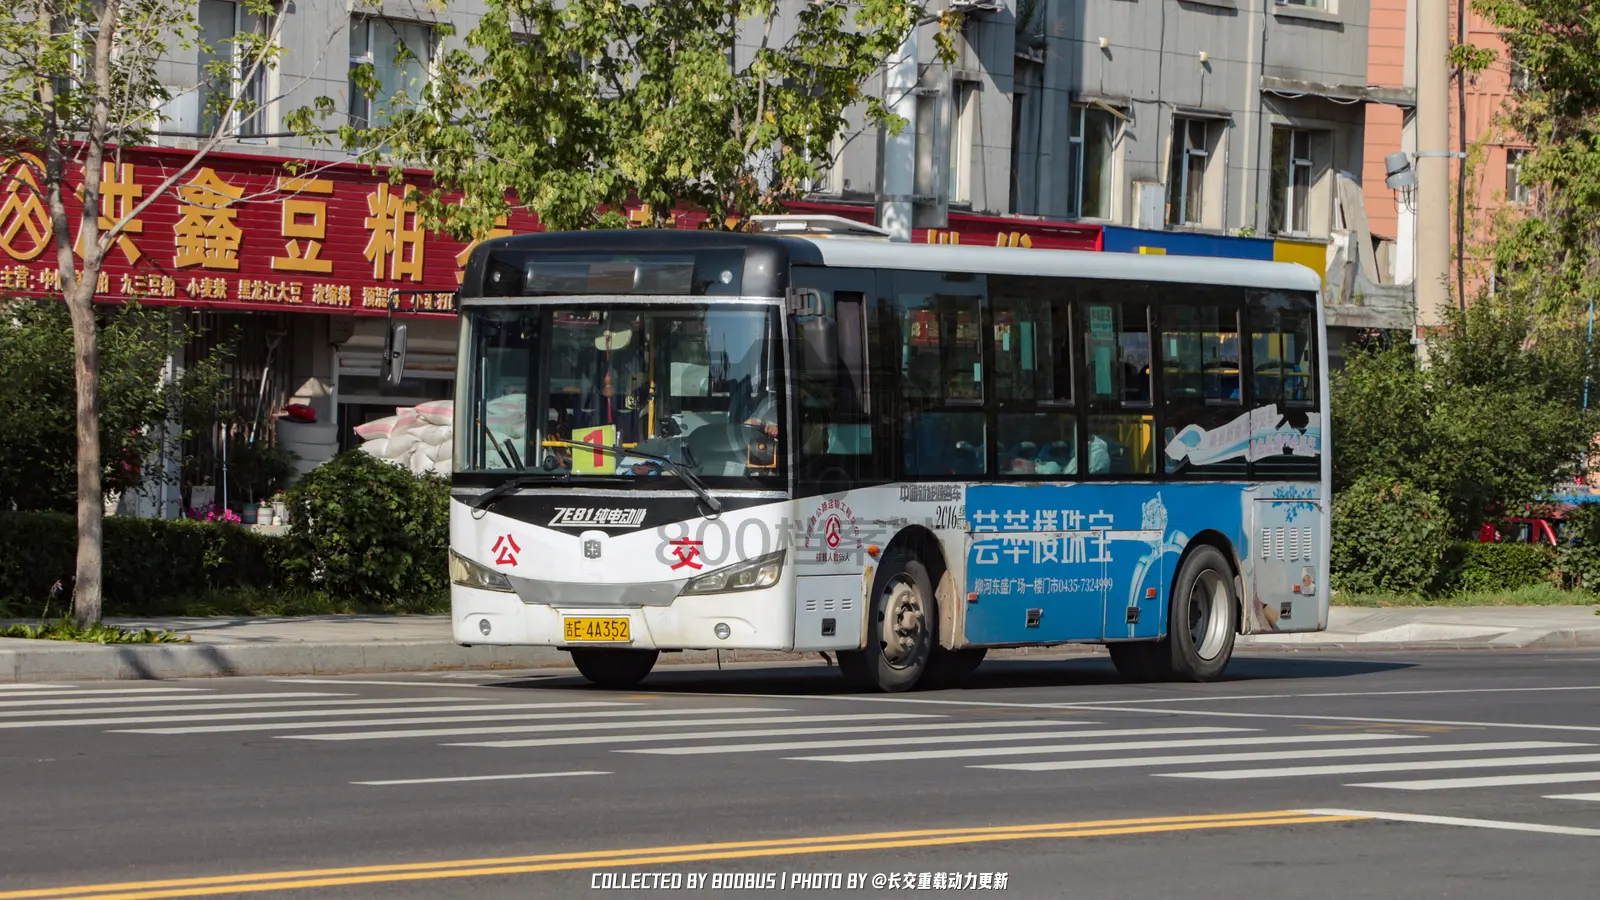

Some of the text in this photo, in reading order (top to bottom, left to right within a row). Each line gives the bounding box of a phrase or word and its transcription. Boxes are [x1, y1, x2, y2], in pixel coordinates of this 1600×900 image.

[120, 273, 176, 297] 九三豆粕
[238, 279, 303, 303] 黑龙江大豆
[312, 283, 351, 306] 浓缩料
[583, 428, 604, 469] 1
